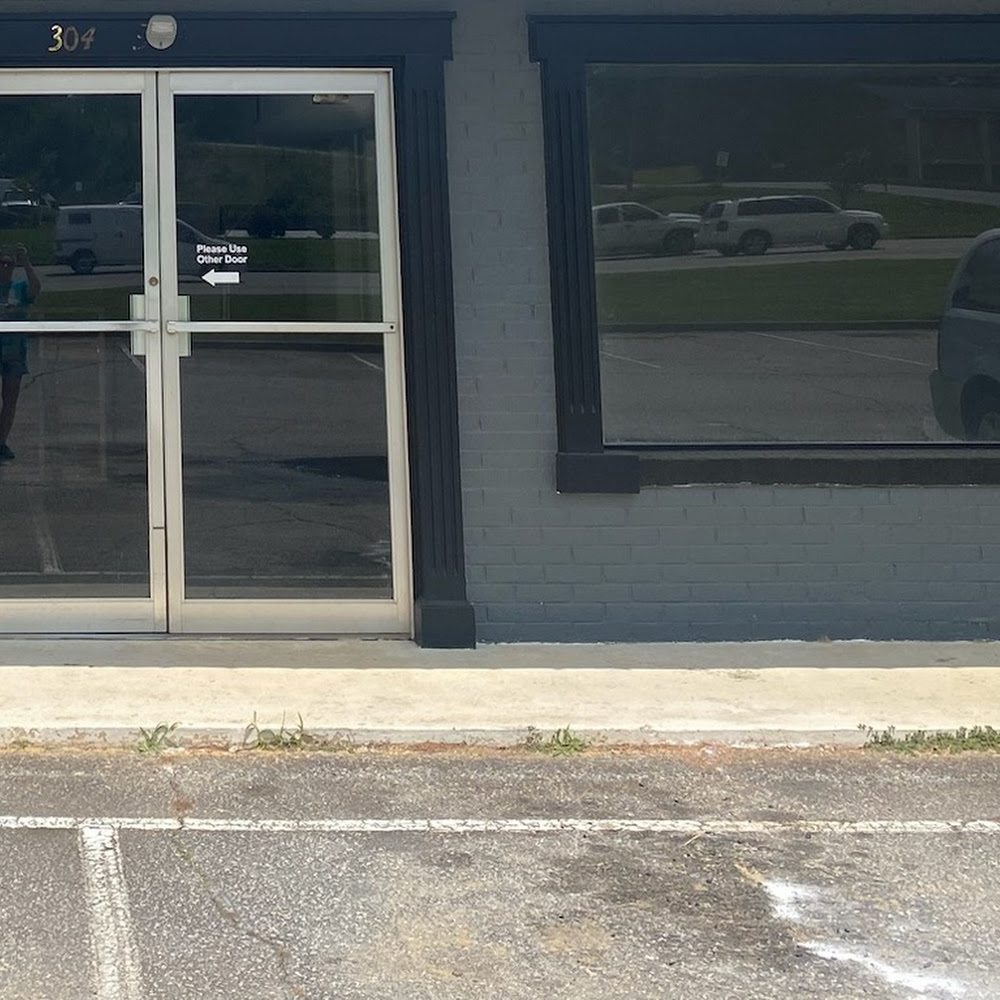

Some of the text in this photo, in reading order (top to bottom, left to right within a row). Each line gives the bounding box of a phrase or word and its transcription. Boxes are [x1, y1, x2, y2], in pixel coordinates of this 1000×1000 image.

[47, 24, 97, 52] 304
[196, 244, 248, 253] Please Use
[196, 255, 248, 264] Other Door
